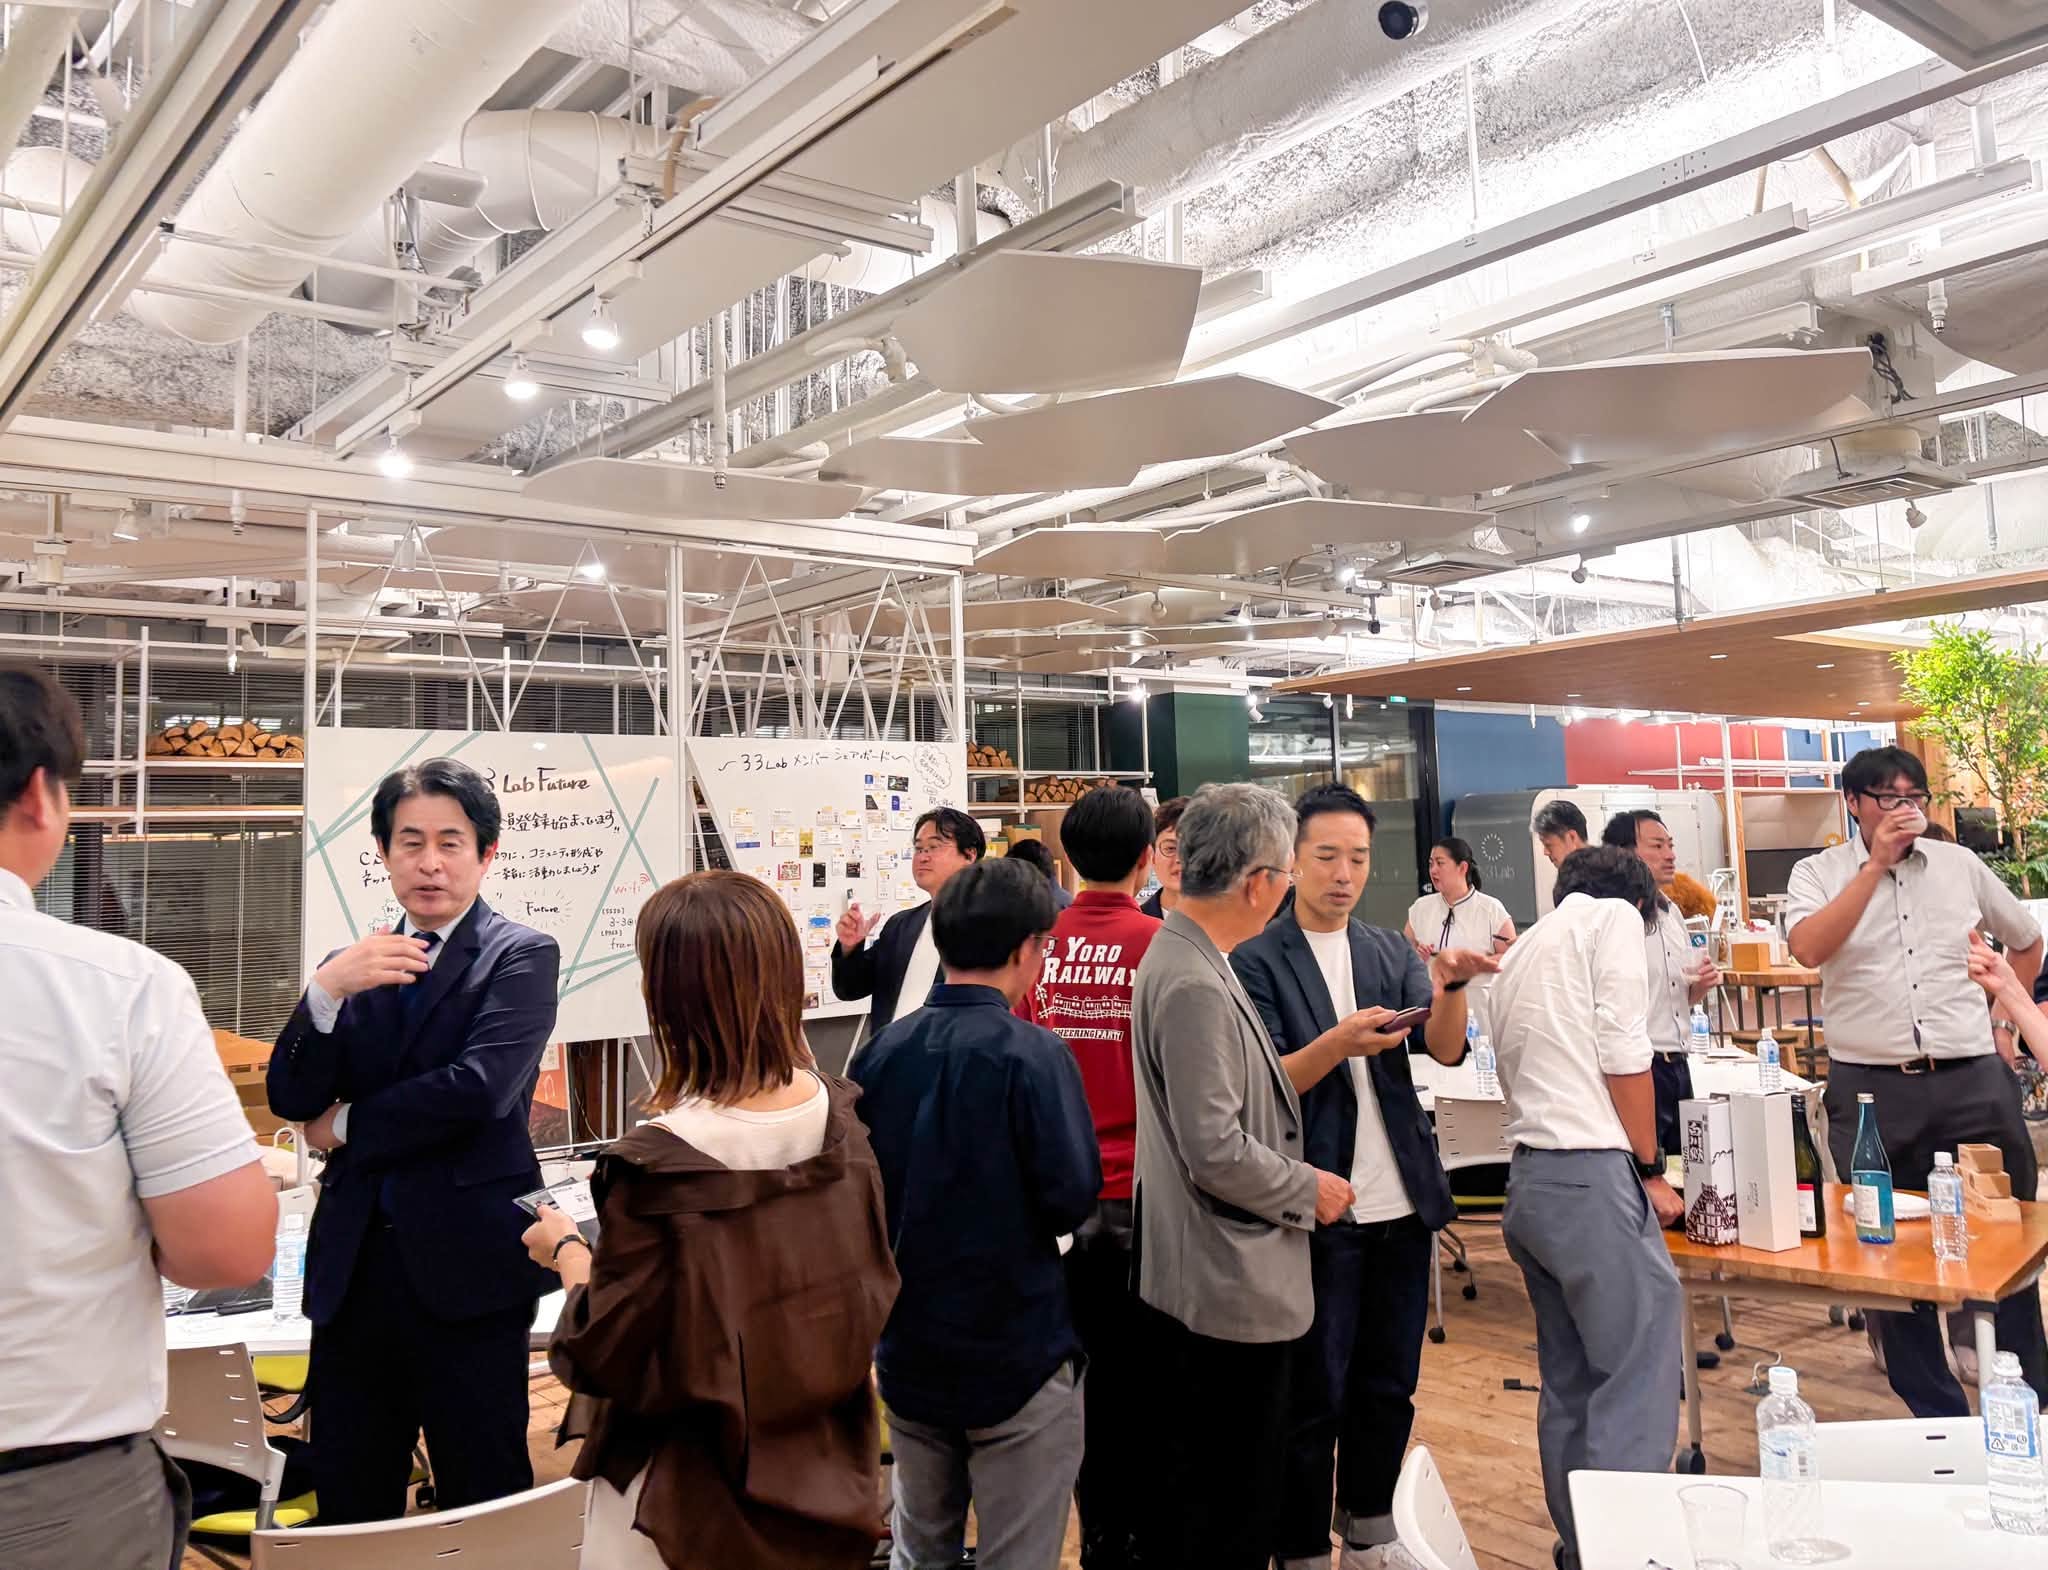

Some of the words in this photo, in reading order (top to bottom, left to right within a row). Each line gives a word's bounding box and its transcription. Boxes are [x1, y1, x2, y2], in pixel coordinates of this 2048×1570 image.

[503, 774, 535, 793] Lab
[537, 767, 591, 792] Future
[524, 901, 560, 916] Future
[609, 916, 637, 928] 3-3@
[1064, 936, 1122, 963] YORO
[1042, 957, 1137, 987] RAILWAY
[1096, 1029, 1121, 1040] PARTY
